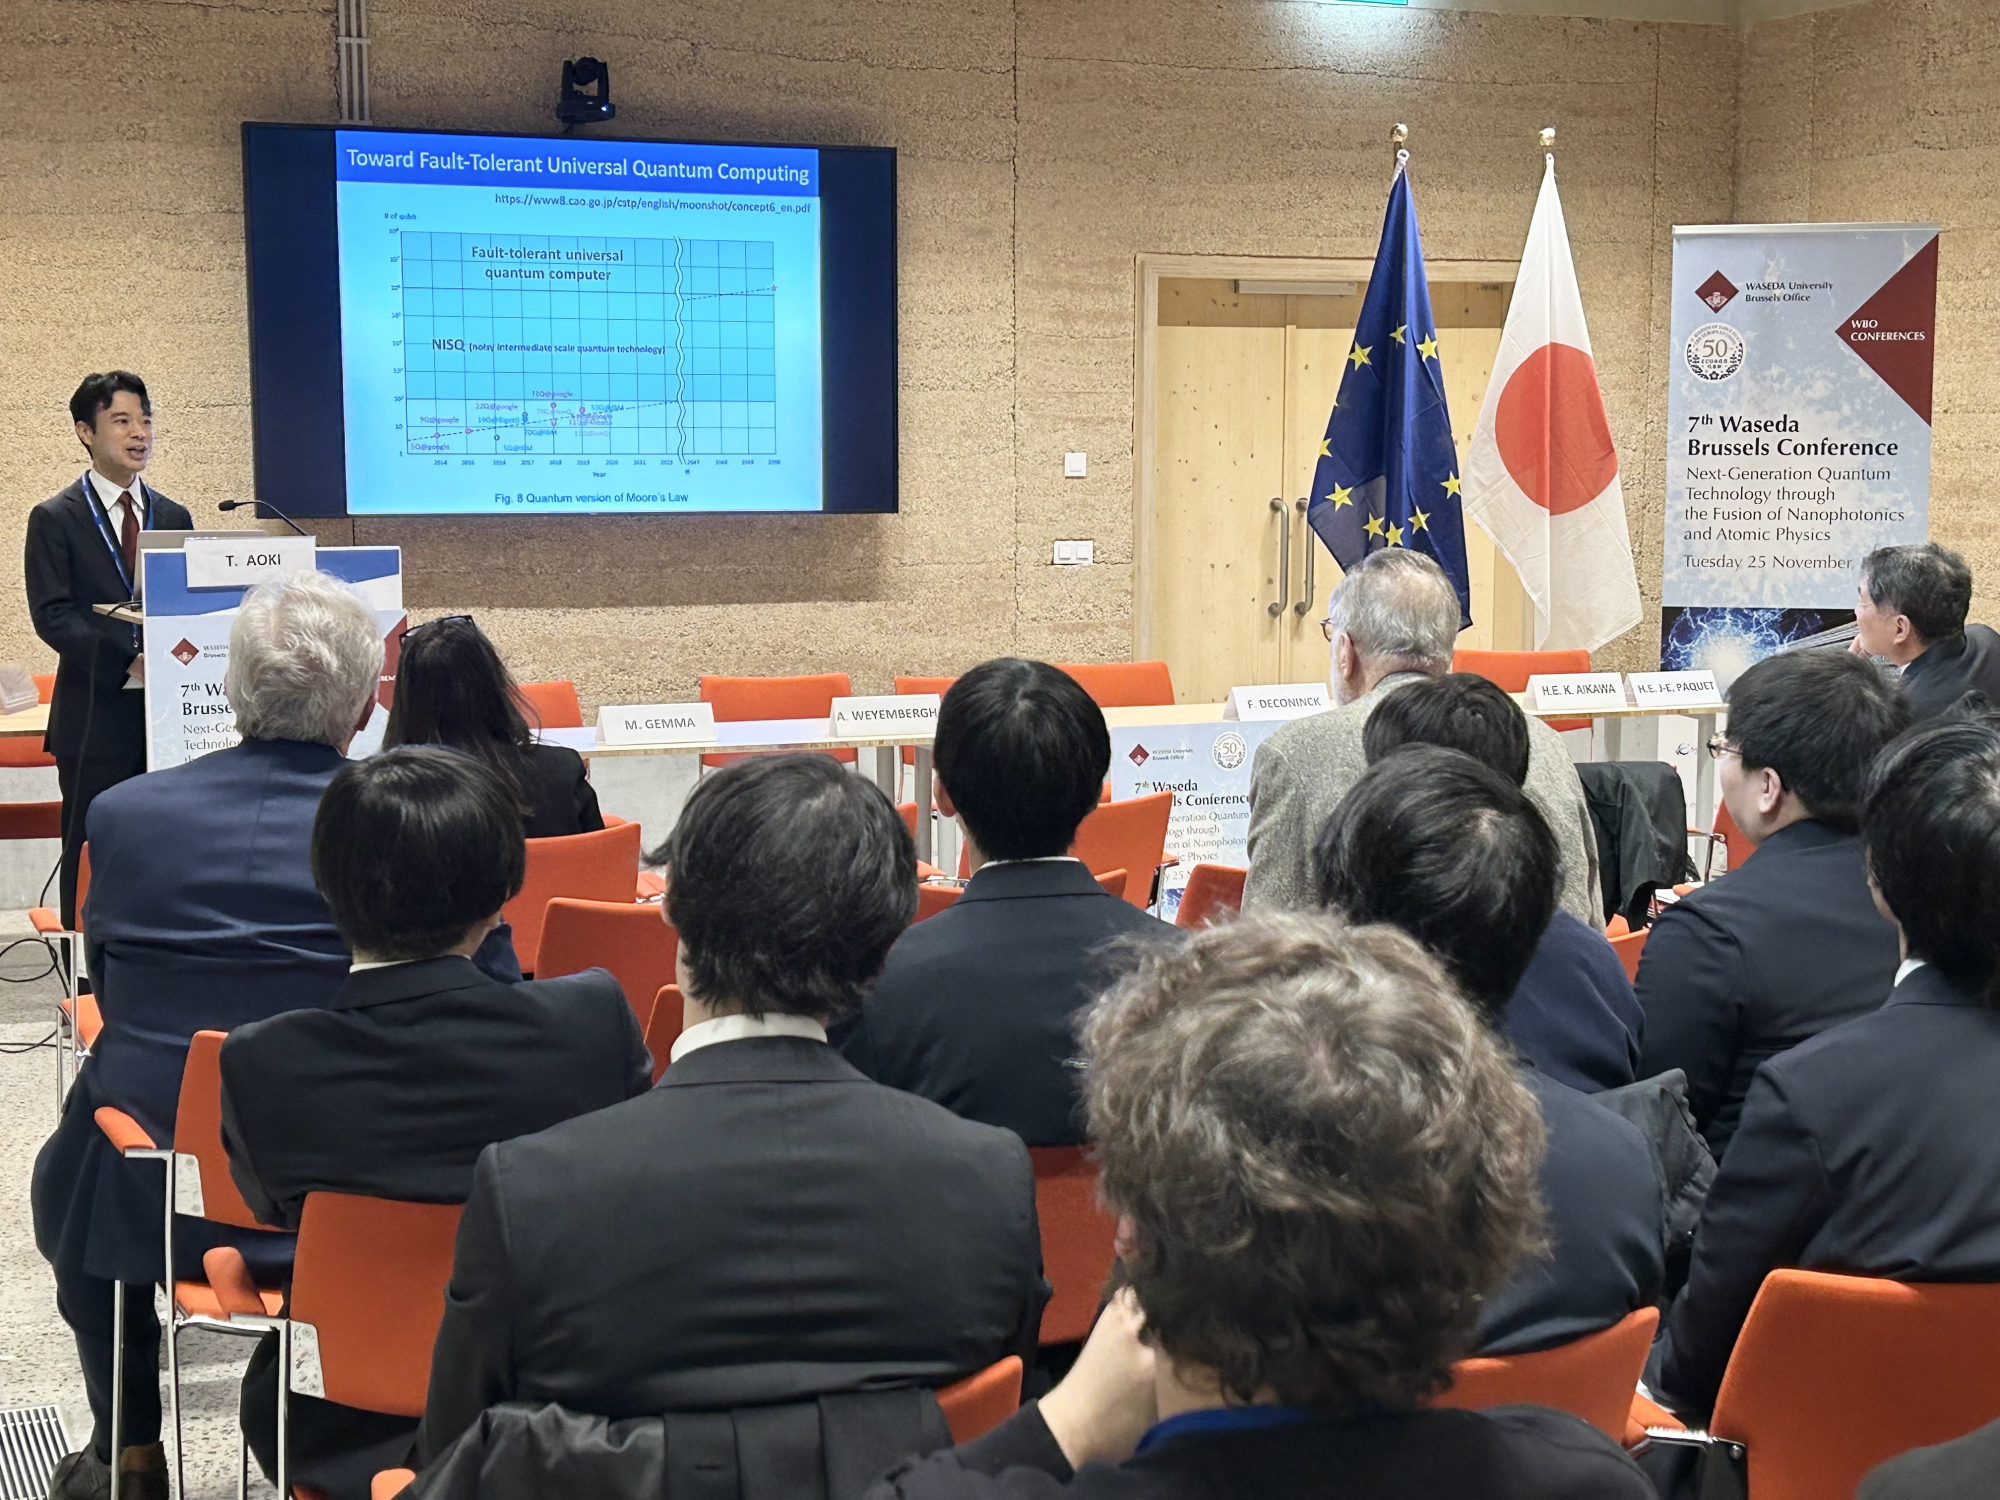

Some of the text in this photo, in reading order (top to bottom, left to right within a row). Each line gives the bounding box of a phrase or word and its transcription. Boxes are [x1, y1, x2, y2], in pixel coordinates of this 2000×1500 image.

[347, 149, 809, 186] Toward Fault-Tolerant Universal Quantum Computing
[471, 246, 624, 262] Fault-tolerant universal
[485, 268, 612, 283] quantum computer
[1745, 281, 1834, 292] WASEDA University
[1745, 292, 1811, 302] Brussels Office
[1851, 319, 1879, 329] WBO
[1850, 331, 1926, 341] CONFERENCES
[432, 338, 465, 353] NISQ
[578, 345, 615, 354] quantum
[1702, 339, 1728, 358] 50
[1719, 414, 1800, 433] Waseda
[1688, 437, 1899, 456] Brussels Conference
[1686, 466, 1891, 483] Next-Generation Quantum
[494, 491, 689, 506] Fig. 8 Quantum version of Moore's Law
[1686, 486, 1835, 505] Technology through
[1685, 507, 1905, 525] the Fusion of Nanophotonics
[1683, 527, 1831, 545] and Atomic Physics
[225, 553, 281, 567] T. AOKI
[1683, 554, 1743, 572] Tuesday
[1747, 555, 1766, 568] 25
[1541, 683, 1616, 696] H.E. K. AIKAWA
[1637, 684, 1658, 694] H.E.
[1677, 681, 1715, 692] PAQUET
[183, 702, 233, 716] Brusse
[1247, 697, 1322, 709] F. DECONINCK
[836, 708, 938, 722] A. WEYEMBERGH
[624, 717, 696, 730] M. GEMMA
[184, 737, 240, 750] Technolo
[1222, 742, 1237, 755] 50
[1152, 779, 1198, 793] Waseda
[1209, 811, 1249, 823] Quantum
[1187, 824, 1220, 837] through
[1193, 837, 1247, 849] Nanophoton
[1188, 851, 1219, 862] Physics
[1172, 870, 1184, 880] 25
